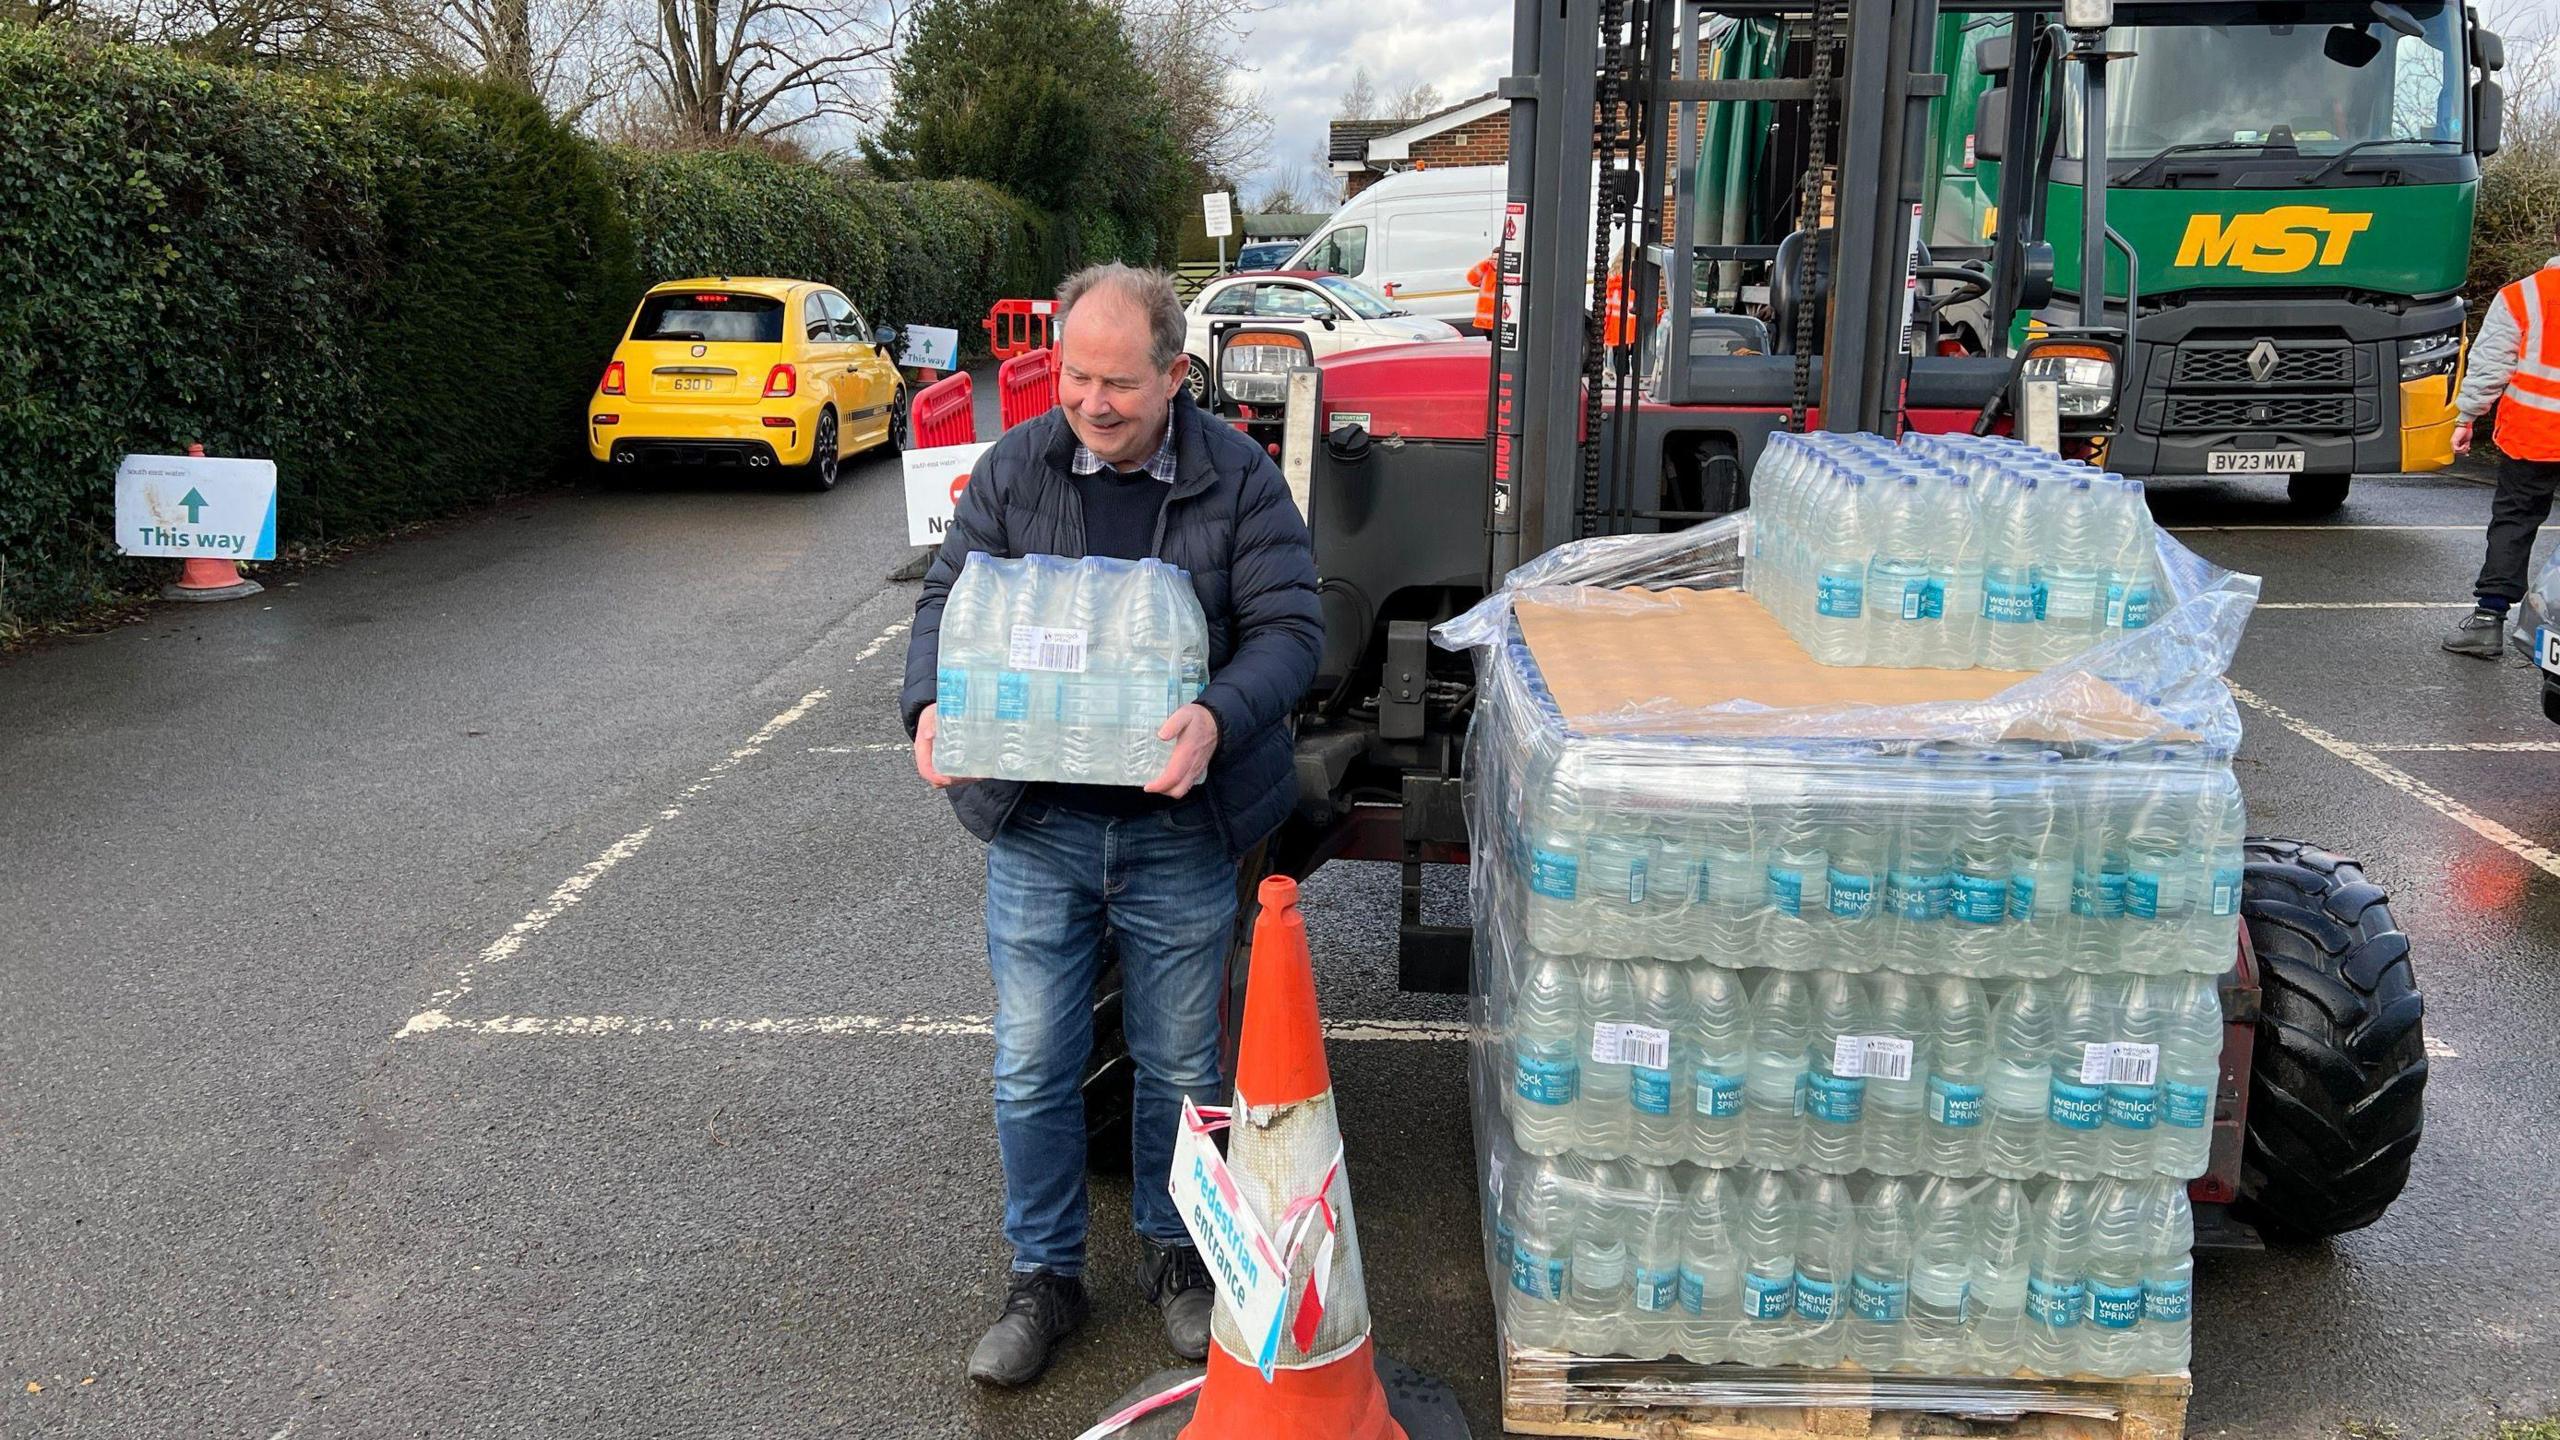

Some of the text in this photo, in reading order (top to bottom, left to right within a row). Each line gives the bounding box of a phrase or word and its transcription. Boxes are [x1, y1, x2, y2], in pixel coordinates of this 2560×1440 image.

[2174, 205, 2374, 273] MST
[907, 354, 946, 367] This way
[2216, 454, 2296, 469] BV23 MVA
[127, 468, 147, 476] south
[139, 526, 246, 554] This way
[1988, 595, 2033, 608] wenlock
[1988, 604, 2021, 616] SPRING
[2053, 1095, 2102, 1112] wenlock
[2107, 1096, 2157, 1113] wenlock
[2053, 1105, 2090, 1122] SPRING
[1194, 1156, 1258, 1288] Pedestrian
[1194, 1204, 1246, 1309] entrance
[2099, 1309, 2135, 1321] SPRING
